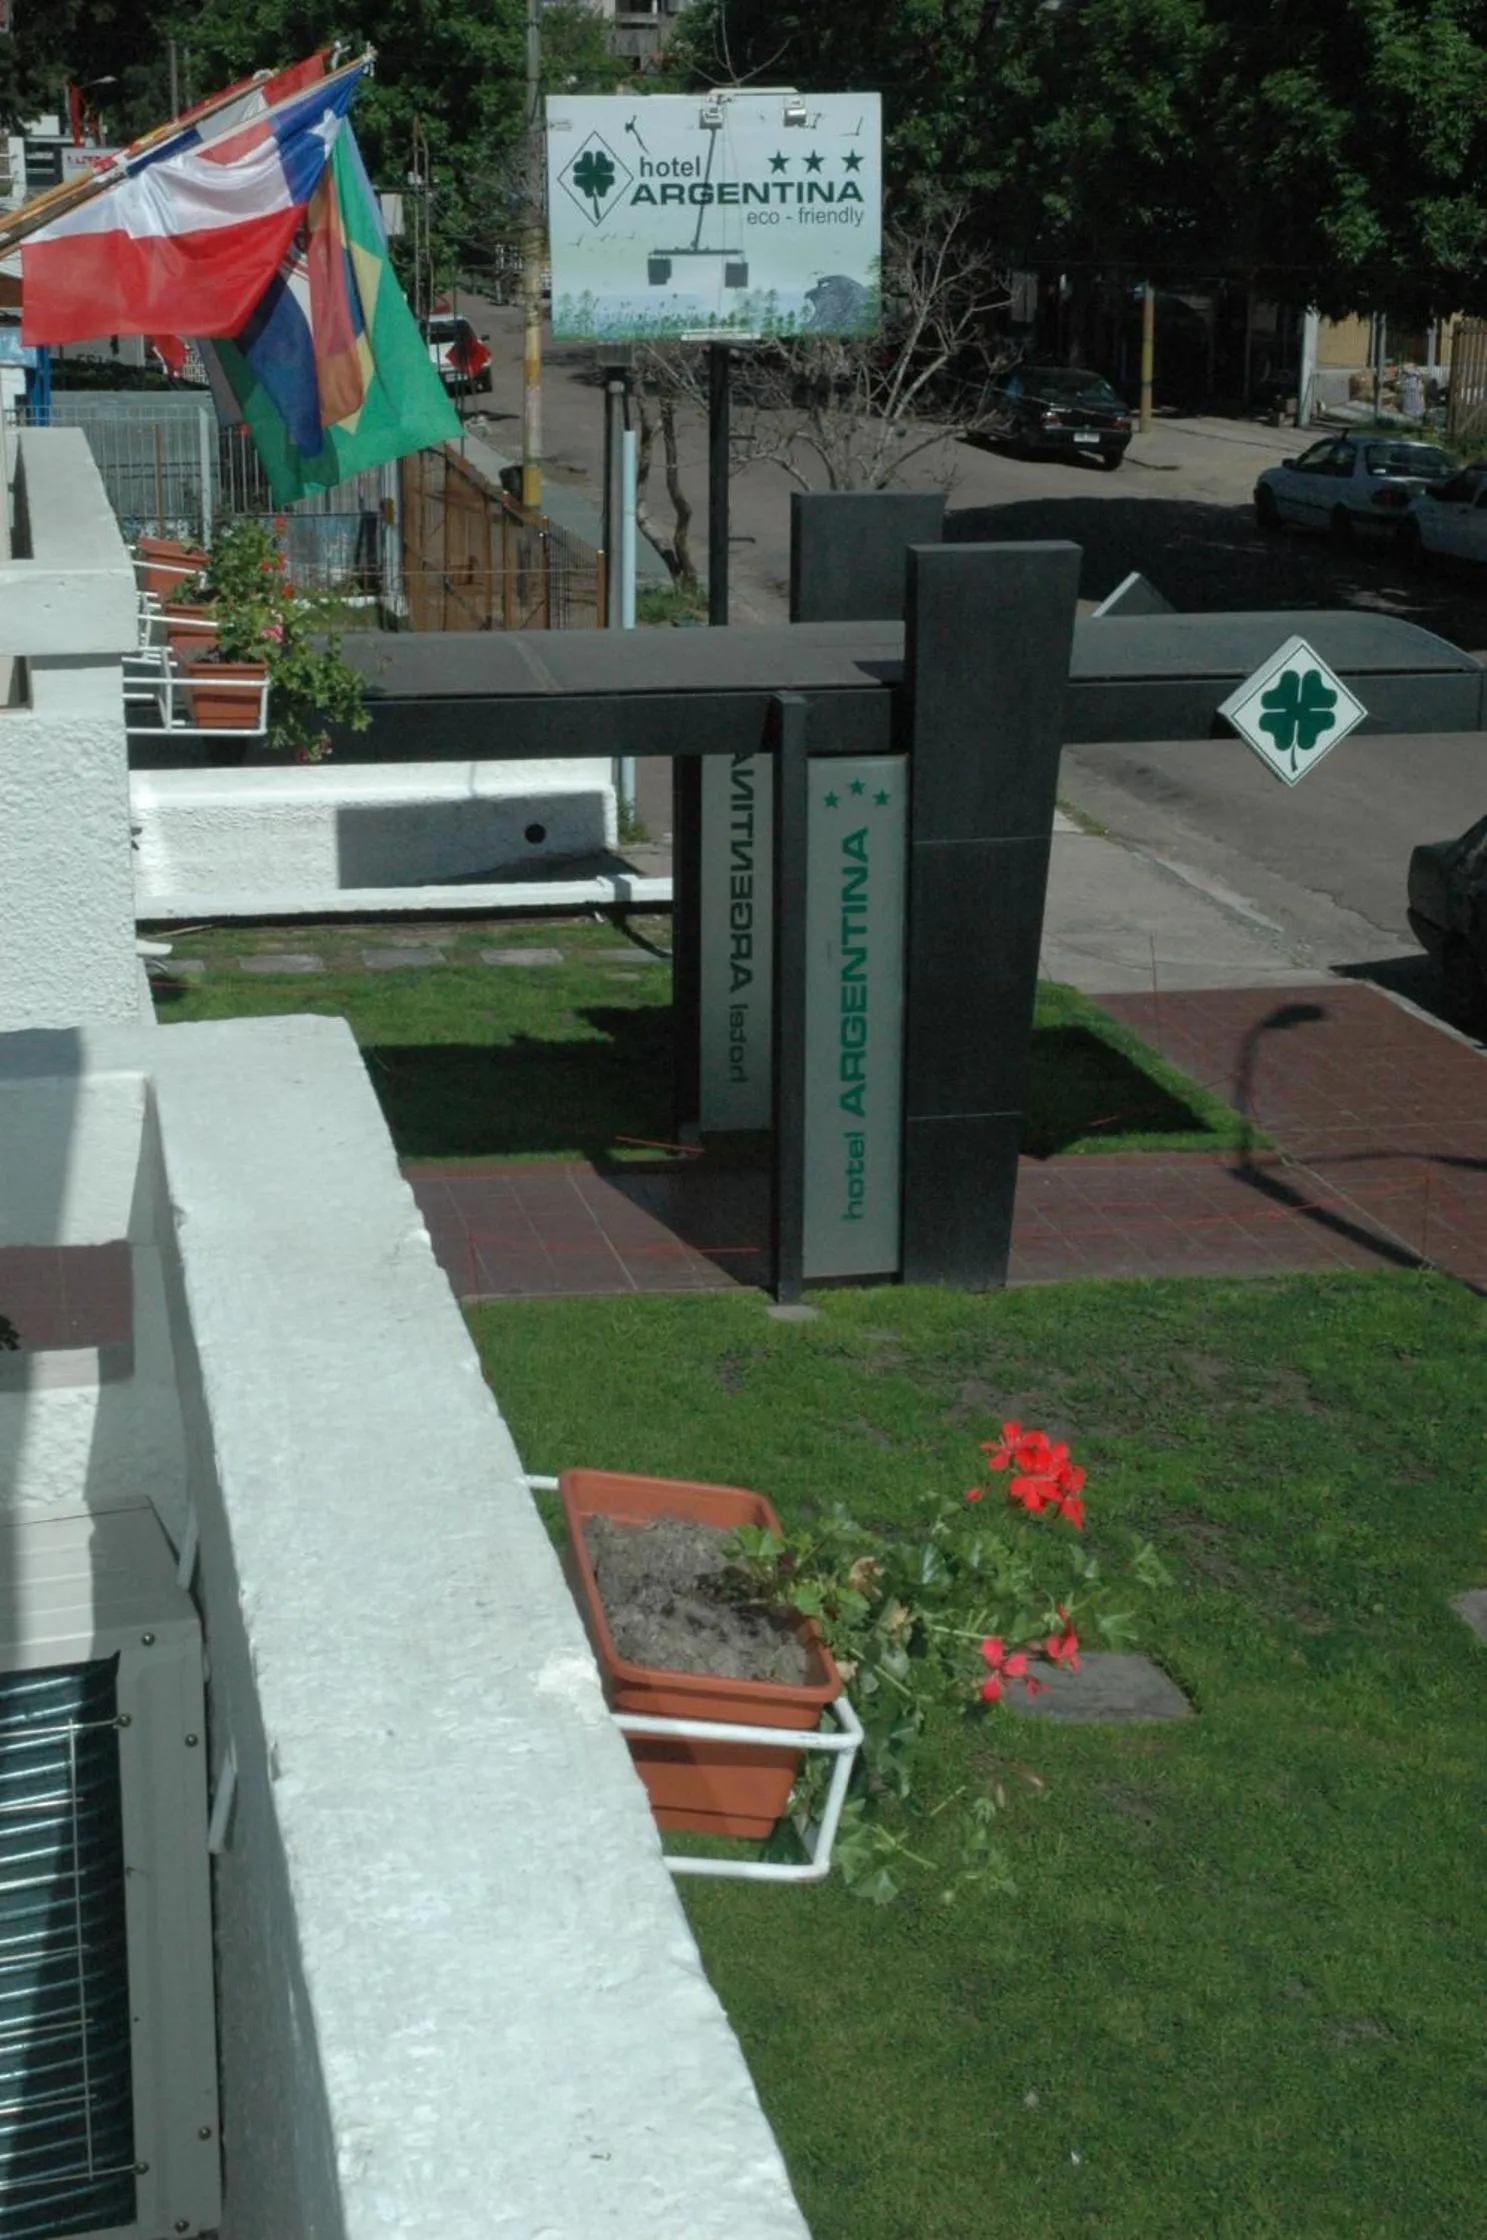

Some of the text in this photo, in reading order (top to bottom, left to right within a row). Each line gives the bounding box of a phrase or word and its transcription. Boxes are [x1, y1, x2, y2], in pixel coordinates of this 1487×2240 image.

[640, 156, 701, 177] hotel
[631, 181, 864, 206] ARGENTINA
[747, 210, 780, 225] eco
[798, 207, 865, 227] friendly
[841, 828, 869, 1220] hotel ARGENTINA
